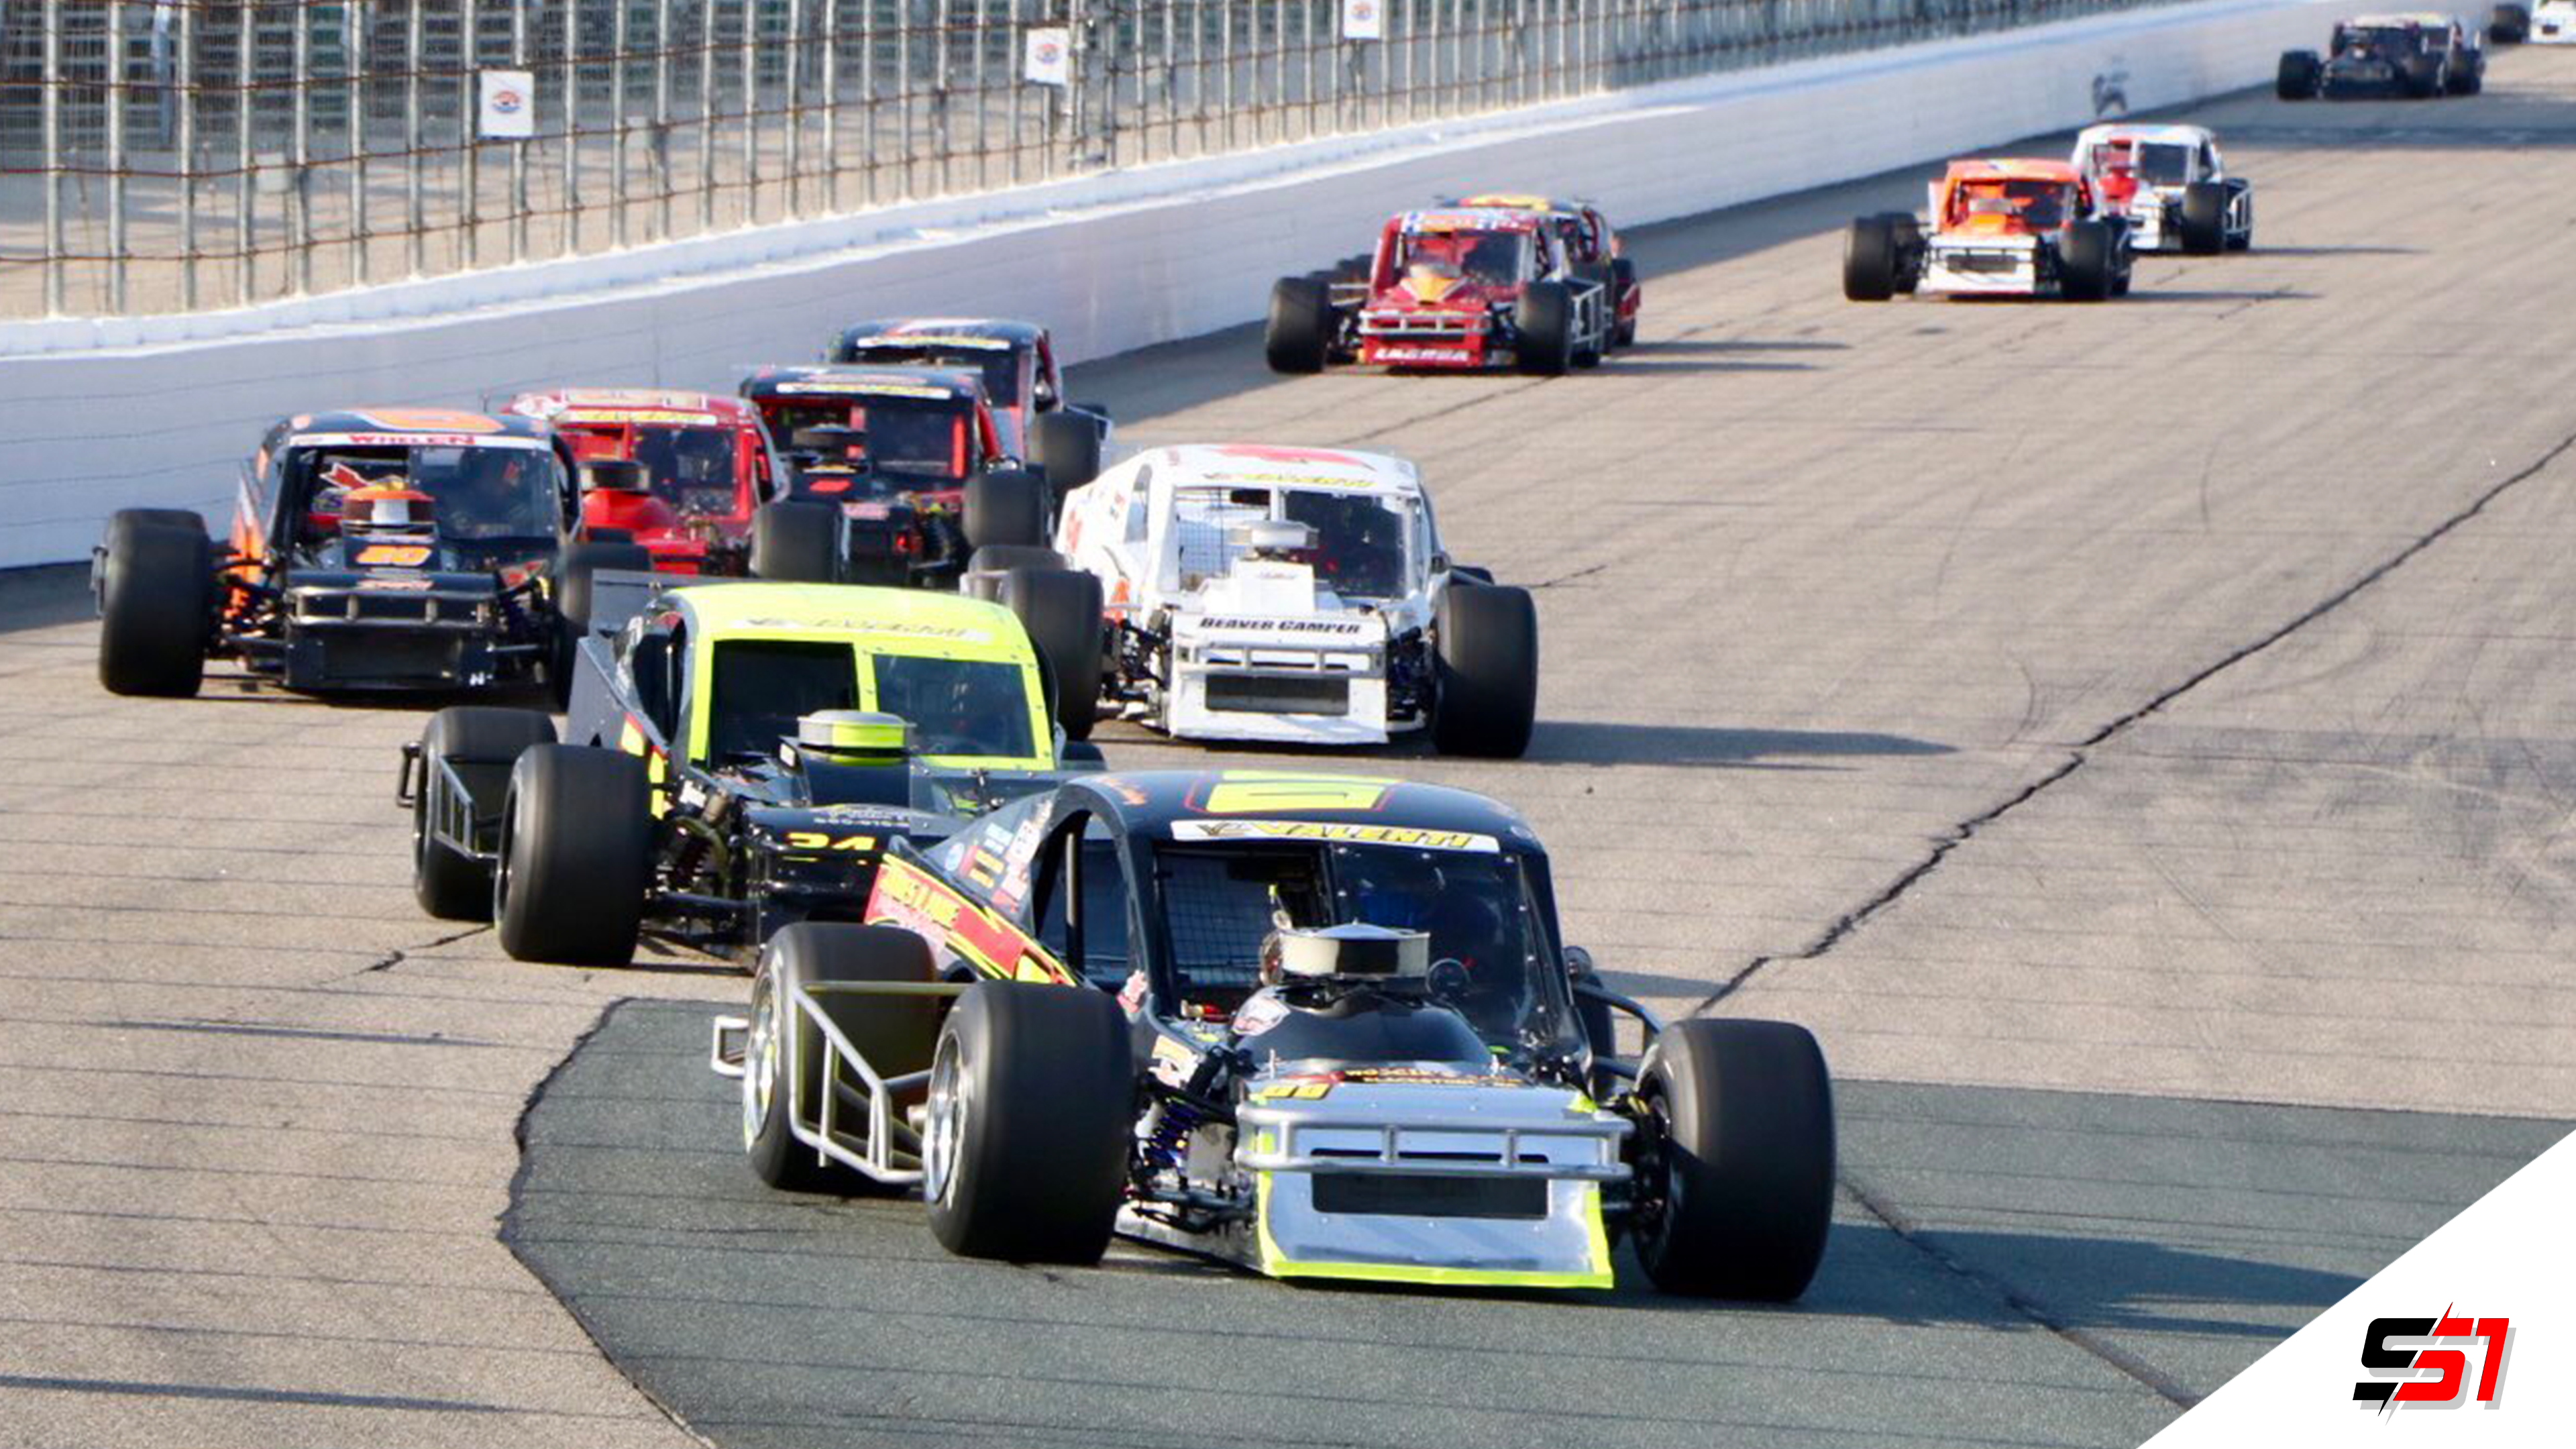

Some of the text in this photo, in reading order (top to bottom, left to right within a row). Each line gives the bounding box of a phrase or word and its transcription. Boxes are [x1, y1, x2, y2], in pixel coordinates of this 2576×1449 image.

[349, 435, 475, 445] WHELEN
[1199, 617, 1362, 633] BEAVER CAMPER
[1248, 820, 1473, 849] VALENTI
